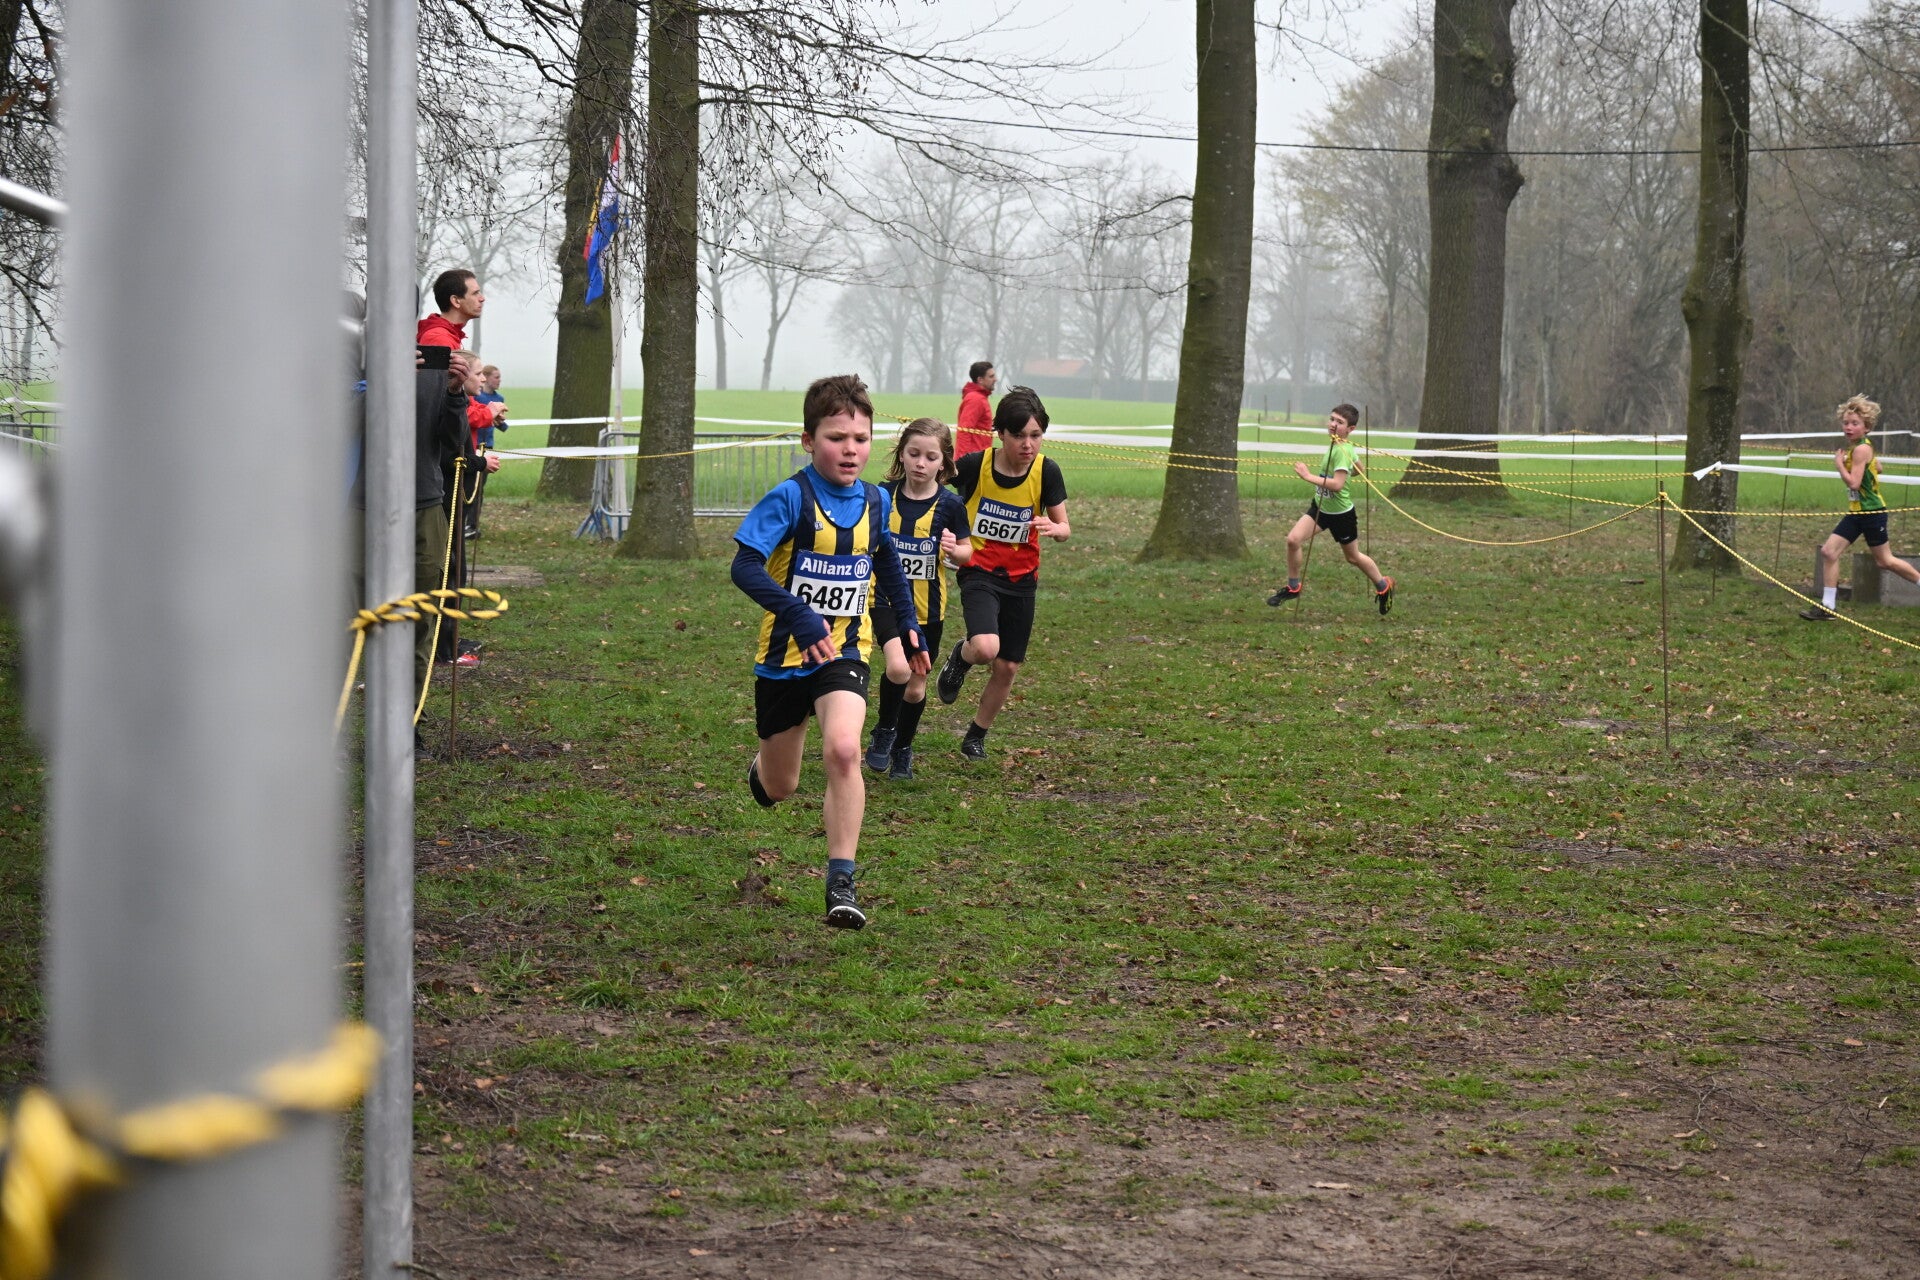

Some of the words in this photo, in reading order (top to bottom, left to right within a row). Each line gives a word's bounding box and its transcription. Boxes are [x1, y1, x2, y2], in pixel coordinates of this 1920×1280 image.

[981, 502, 1019, 519] Allianz
[977, 518, 1021, 541] 6567
[800, 557, 852, 576] Allianz
[796, 582, 857, 611] 6487
